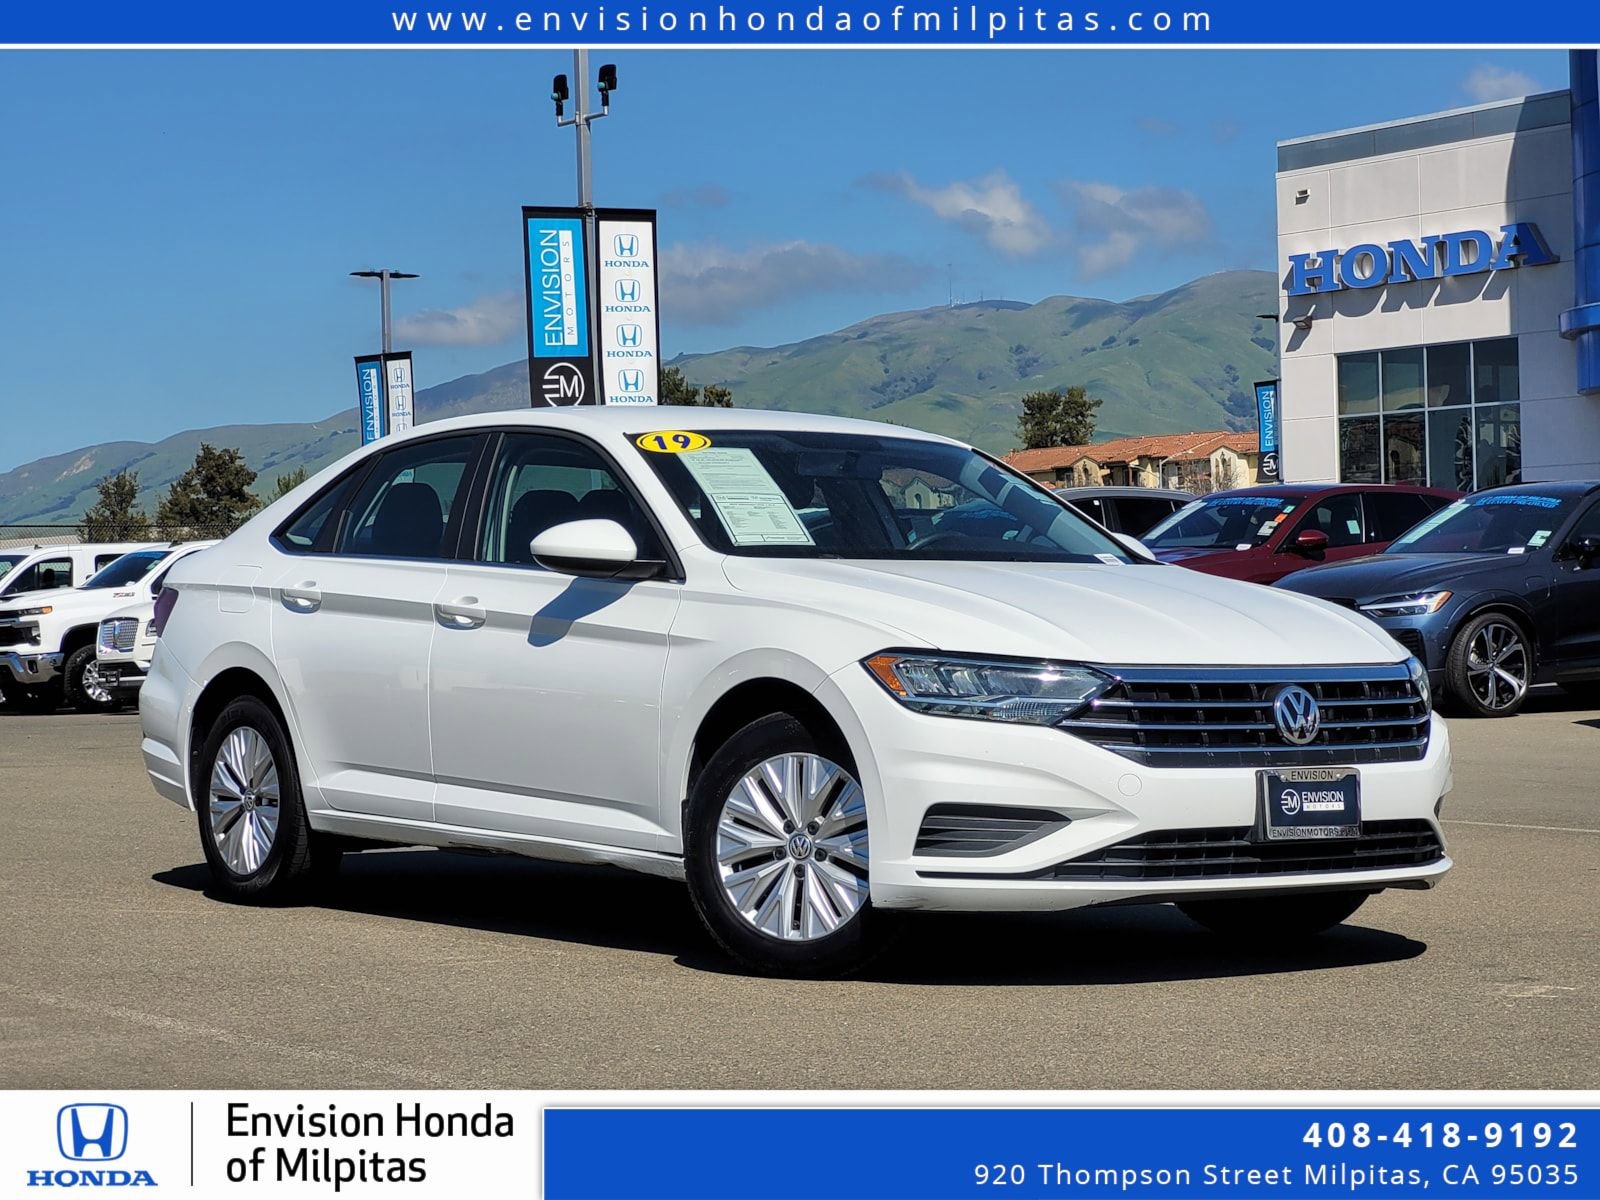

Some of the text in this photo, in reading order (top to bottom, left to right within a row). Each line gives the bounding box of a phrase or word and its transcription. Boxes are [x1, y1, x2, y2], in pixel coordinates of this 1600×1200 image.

[604, 260, 649, 268] HONDA
[1288, 222, 1557, 296] HONDA
[539, 230, 564, 346] ENVISION
[562, 241, 575, 336] MOTORS
[605, 305, 651, 313] HONDA
[607, 350, 653, 358] HONDA
[362, 369, 375, 440] ENVISION
[610, 395, 653, 403] HONDA
[1262, 391, 1274, 447] ENVISION
[652, 434, 691, 450] 19
[1291, 770, 1334, 780] ENVISION
[1302, 791, 1344, 802] ENVISION
